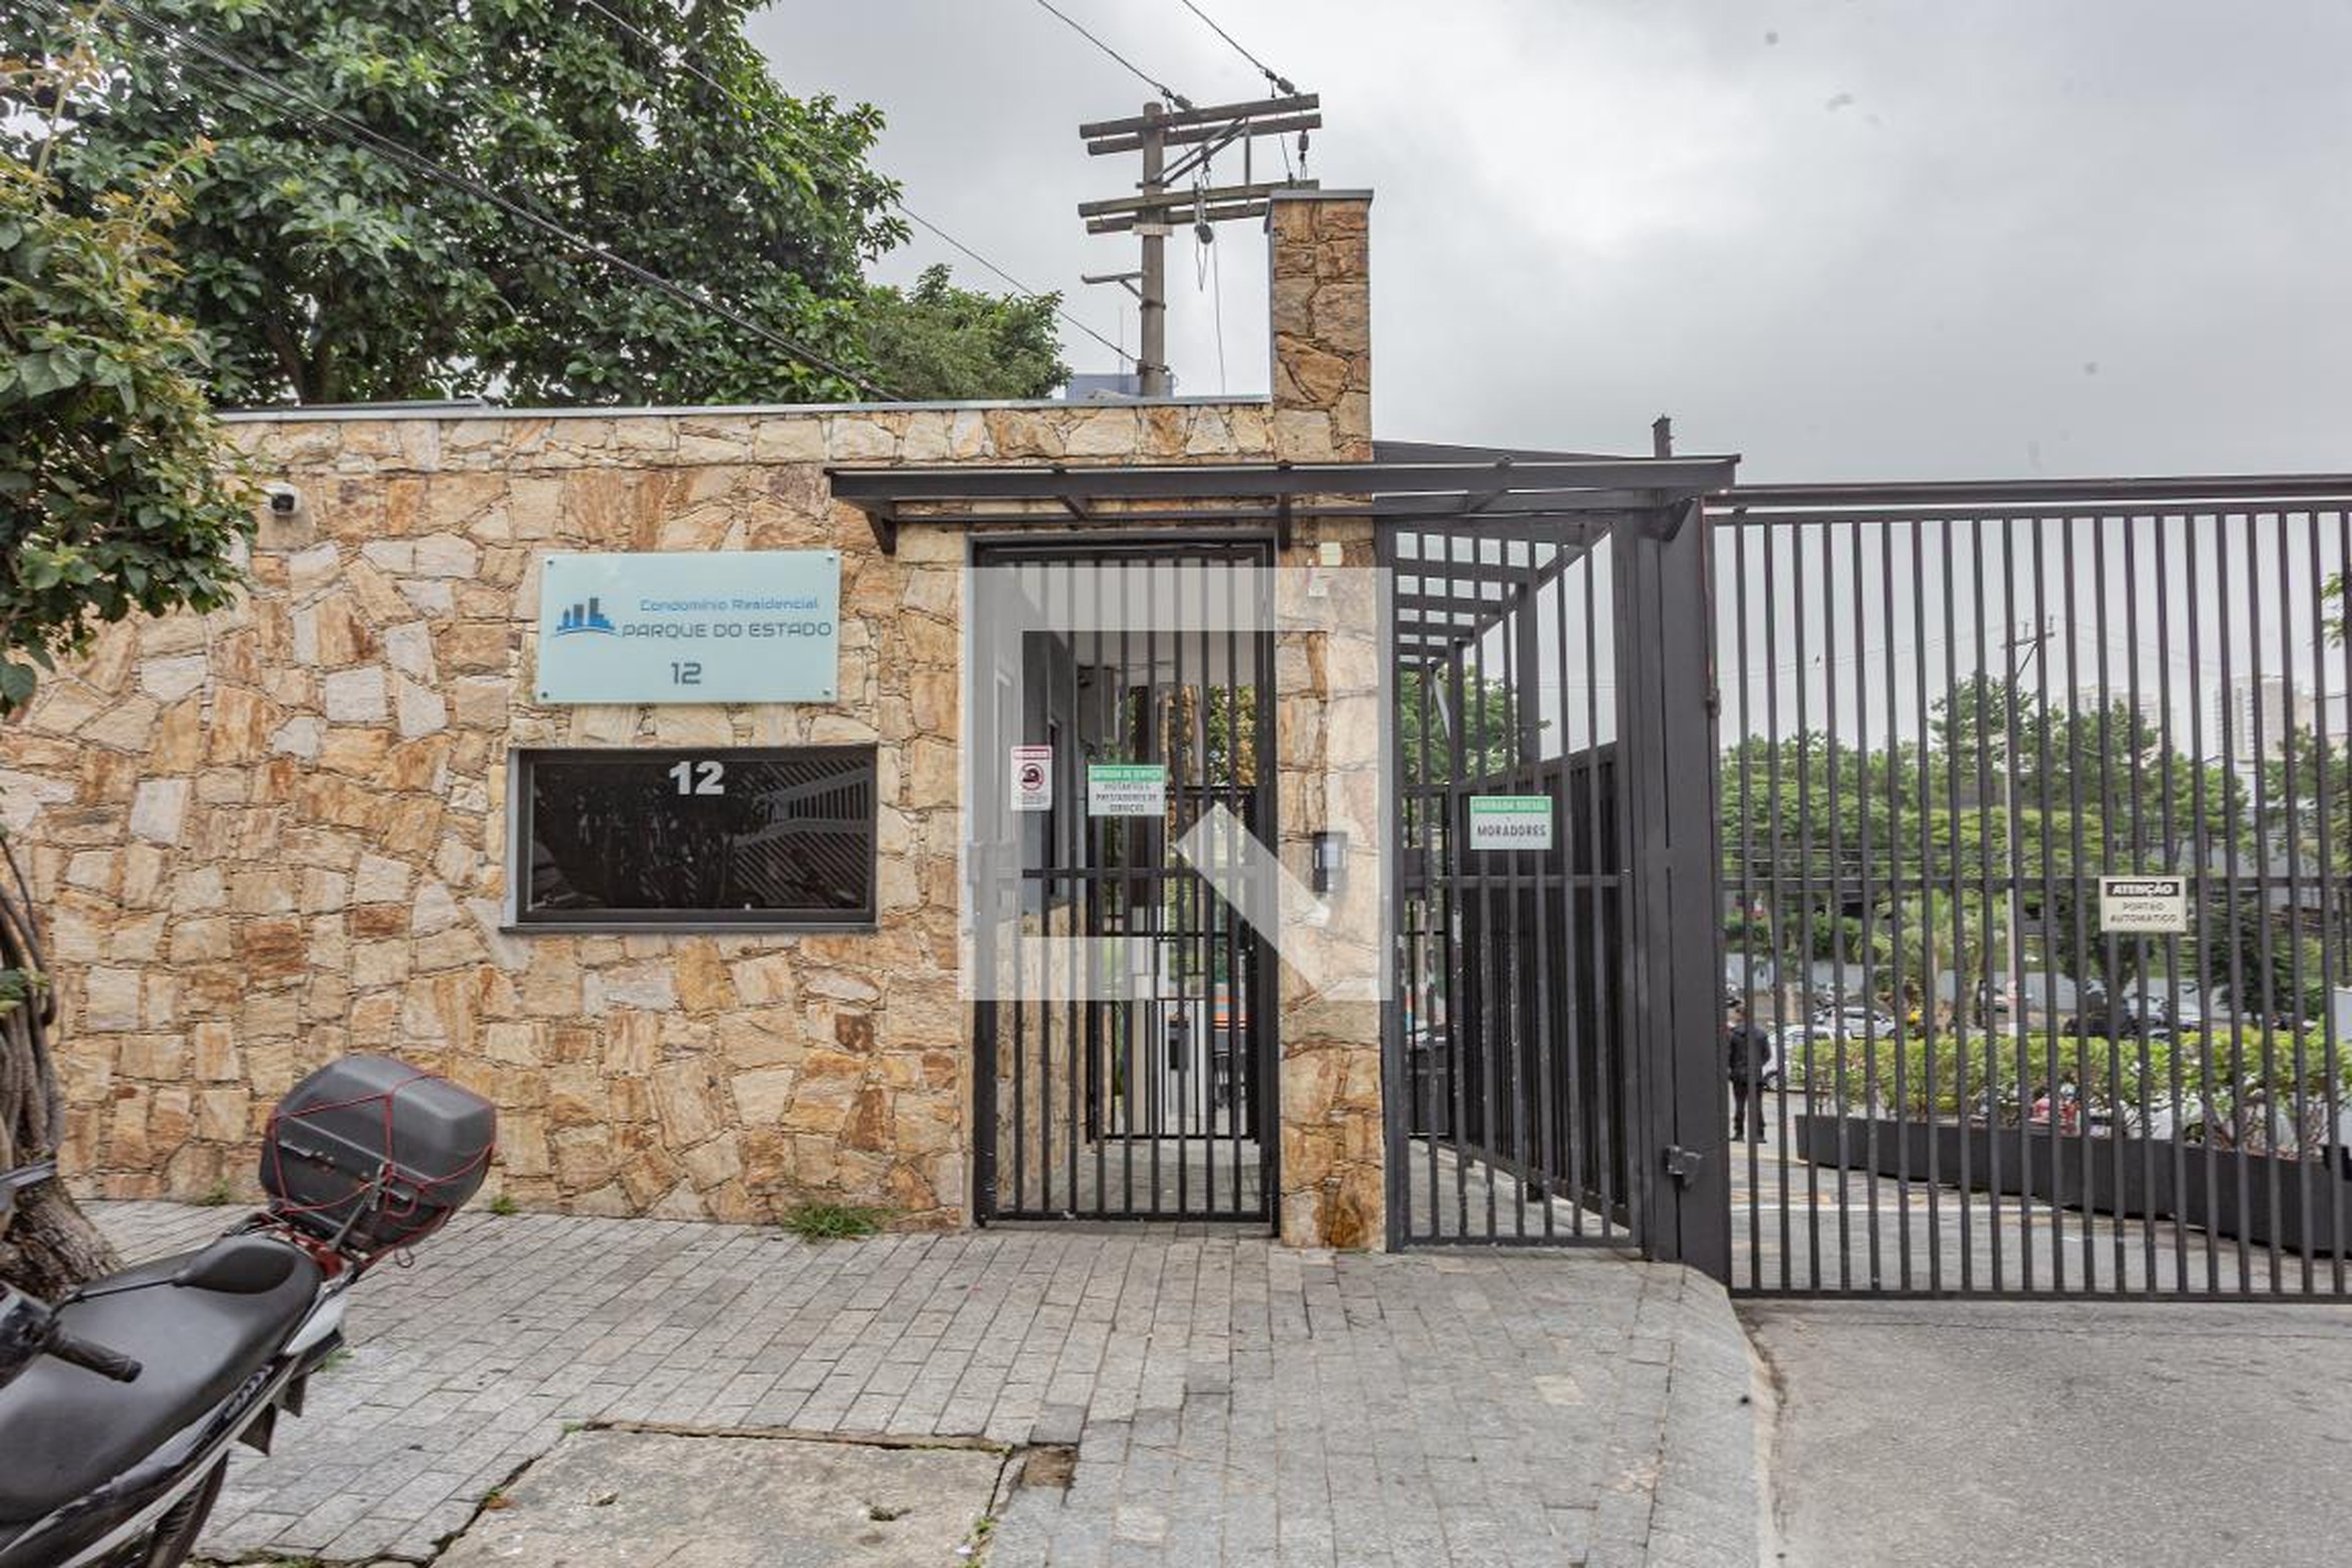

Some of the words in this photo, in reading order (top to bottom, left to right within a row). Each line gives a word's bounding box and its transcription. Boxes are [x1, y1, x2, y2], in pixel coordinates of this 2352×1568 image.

[732, 597, 818, 610] Residencial
[622, 624, 707, 638] PARQUE
[714, 624, 742, 637] DO
[749, 622, 832, 636] ESTADO
[671, 662, 701, 684] 12
[669, 761, 725, 795] 12
[1477, 825, 1547, 836] MORADORES
[2113, 882, 2173, 896] ATENÇÃO
